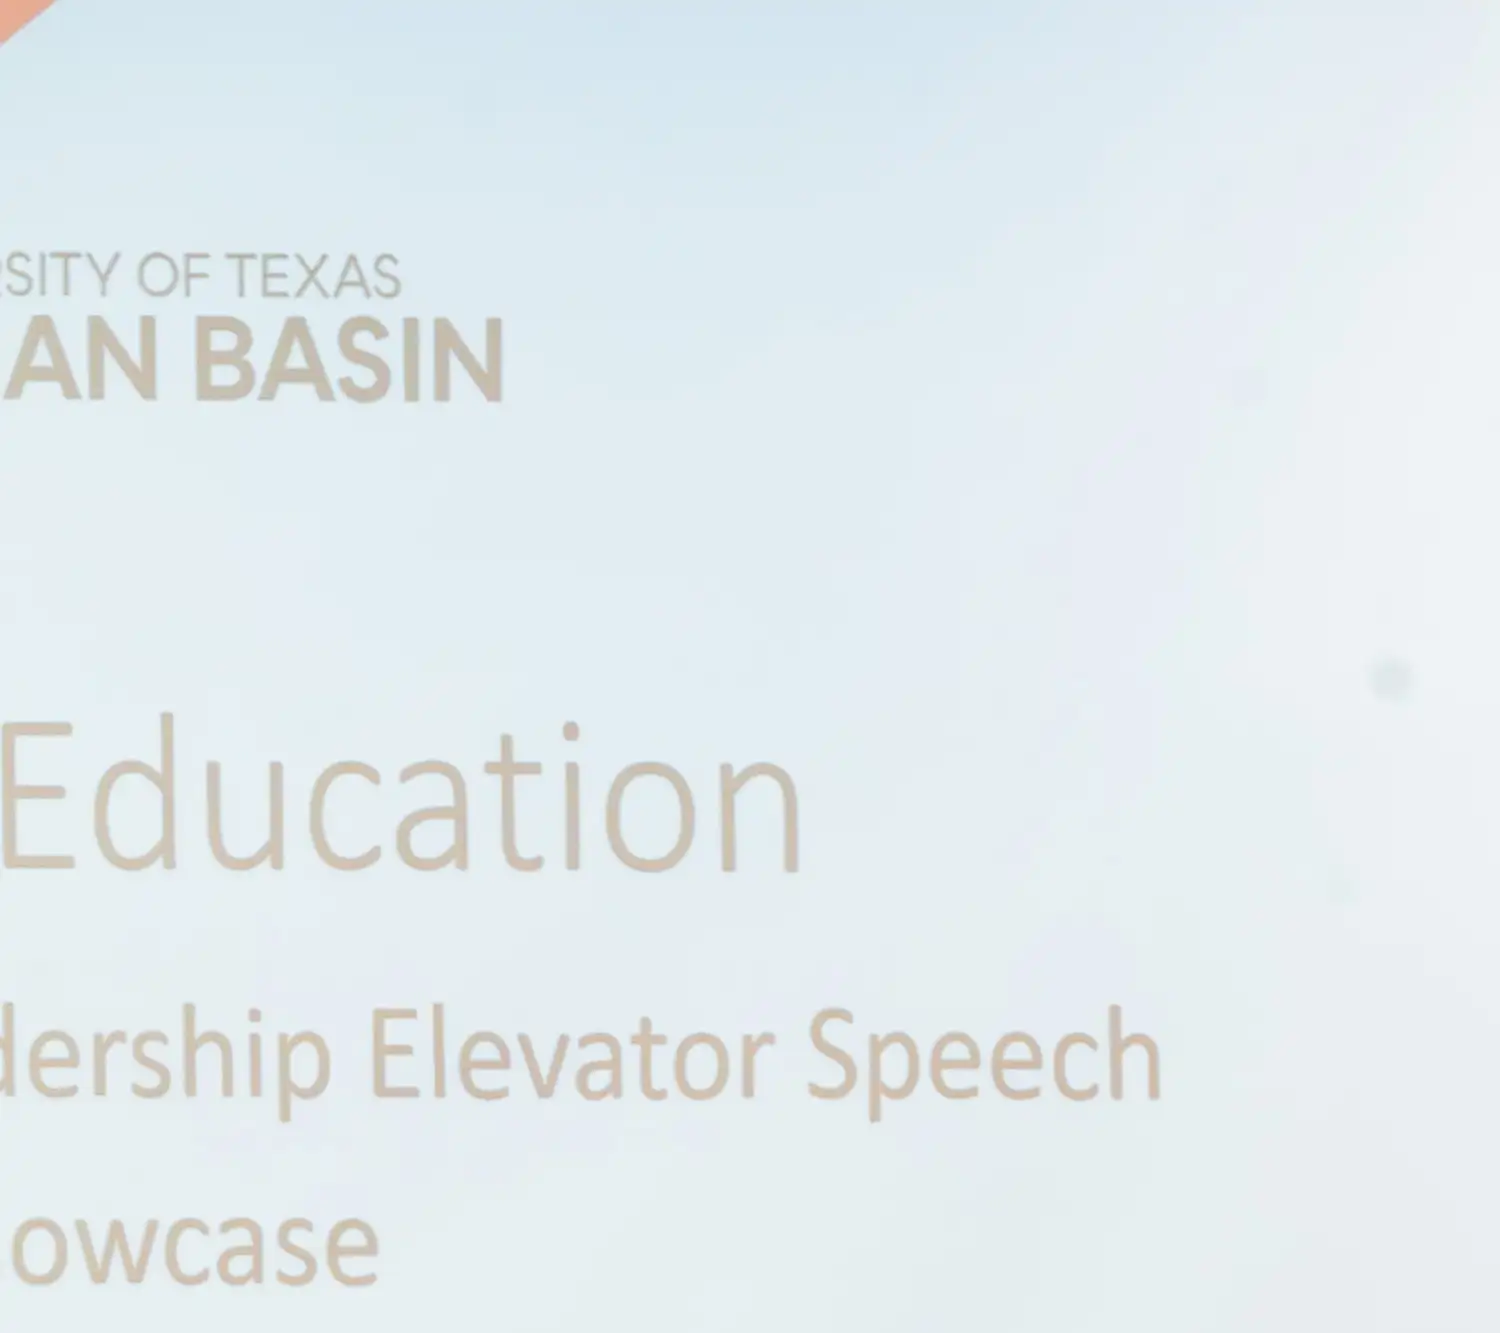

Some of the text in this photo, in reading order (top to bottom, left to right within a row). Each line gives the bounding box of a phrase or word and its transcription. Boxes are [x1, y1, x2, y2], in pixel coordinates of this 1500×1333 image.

[0, 251, 402, 299] SITY OF TEXAS
[3, 314, 503, 404] AN BASIN
[1, 711, 799, 874] Education
[372, 1002, 776, 1102] Elevator
[808, 1004, 1161, 1124] Speech
[11, 1216, 379, 1287] owcase
